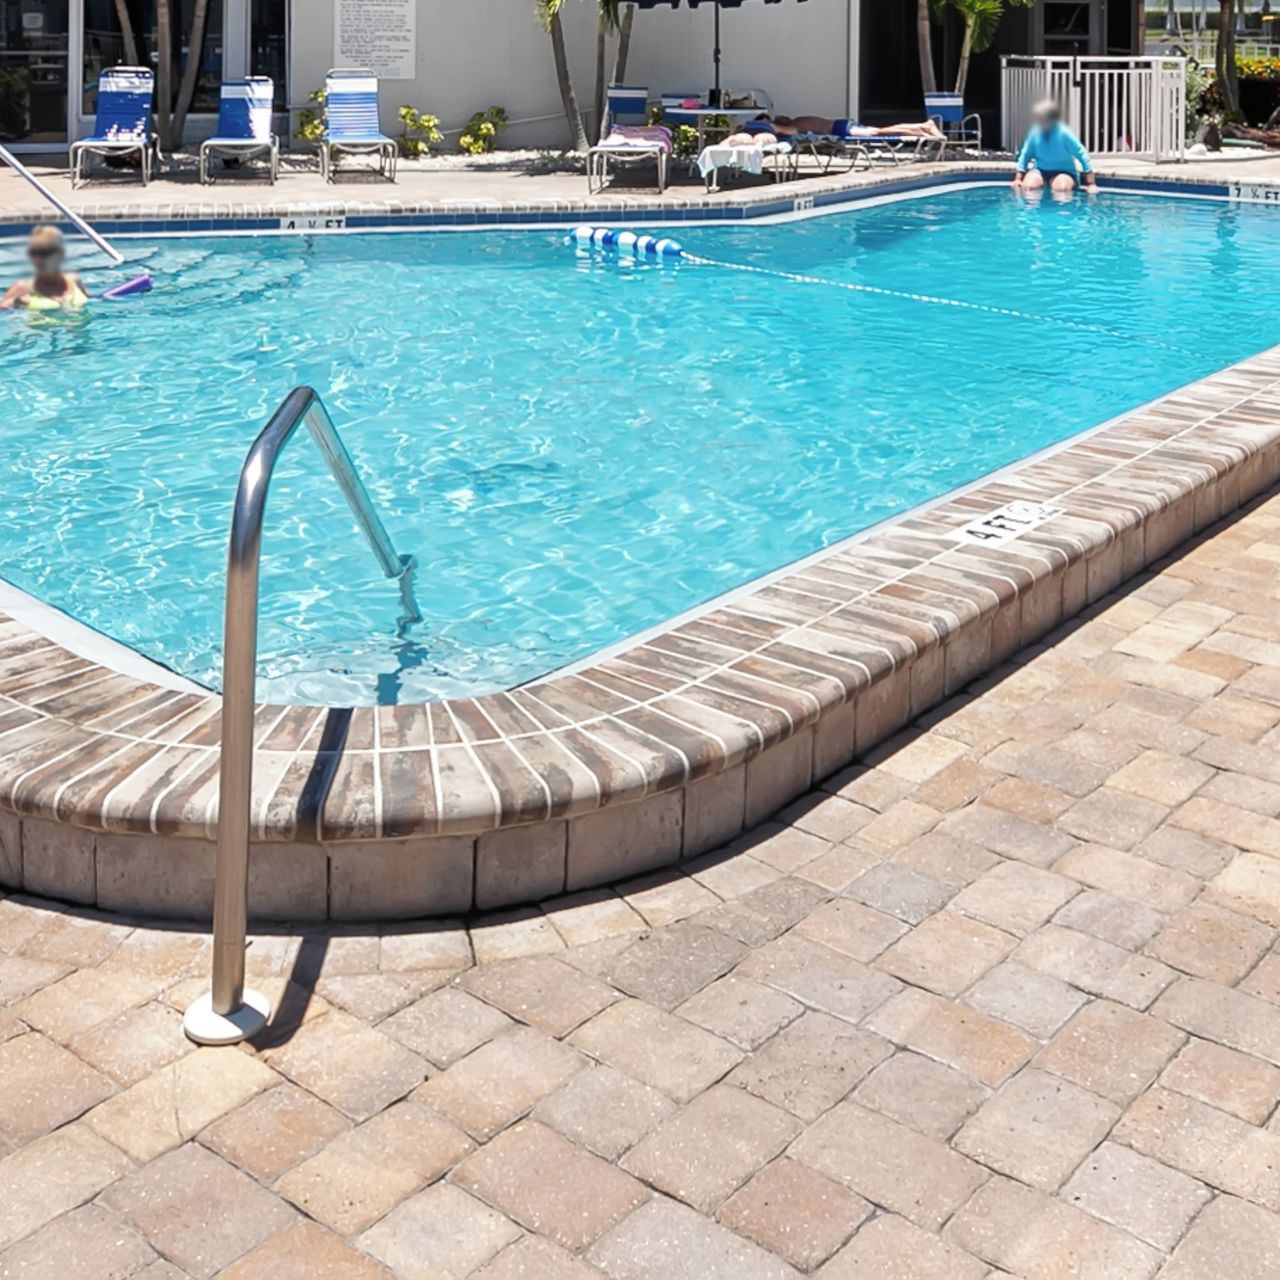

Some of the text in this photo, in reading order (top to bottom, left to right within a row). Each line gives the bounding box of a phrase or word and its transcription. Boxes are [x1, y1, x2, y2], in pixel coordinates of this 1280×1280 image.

[1234, 187, 1242, 198] 7
[1265, 190, 1280, 201] FT
[325, 219, 344, 229] FT
[981, 514, 1033, 532] FT
[965, 529, 1003, 540] 4
